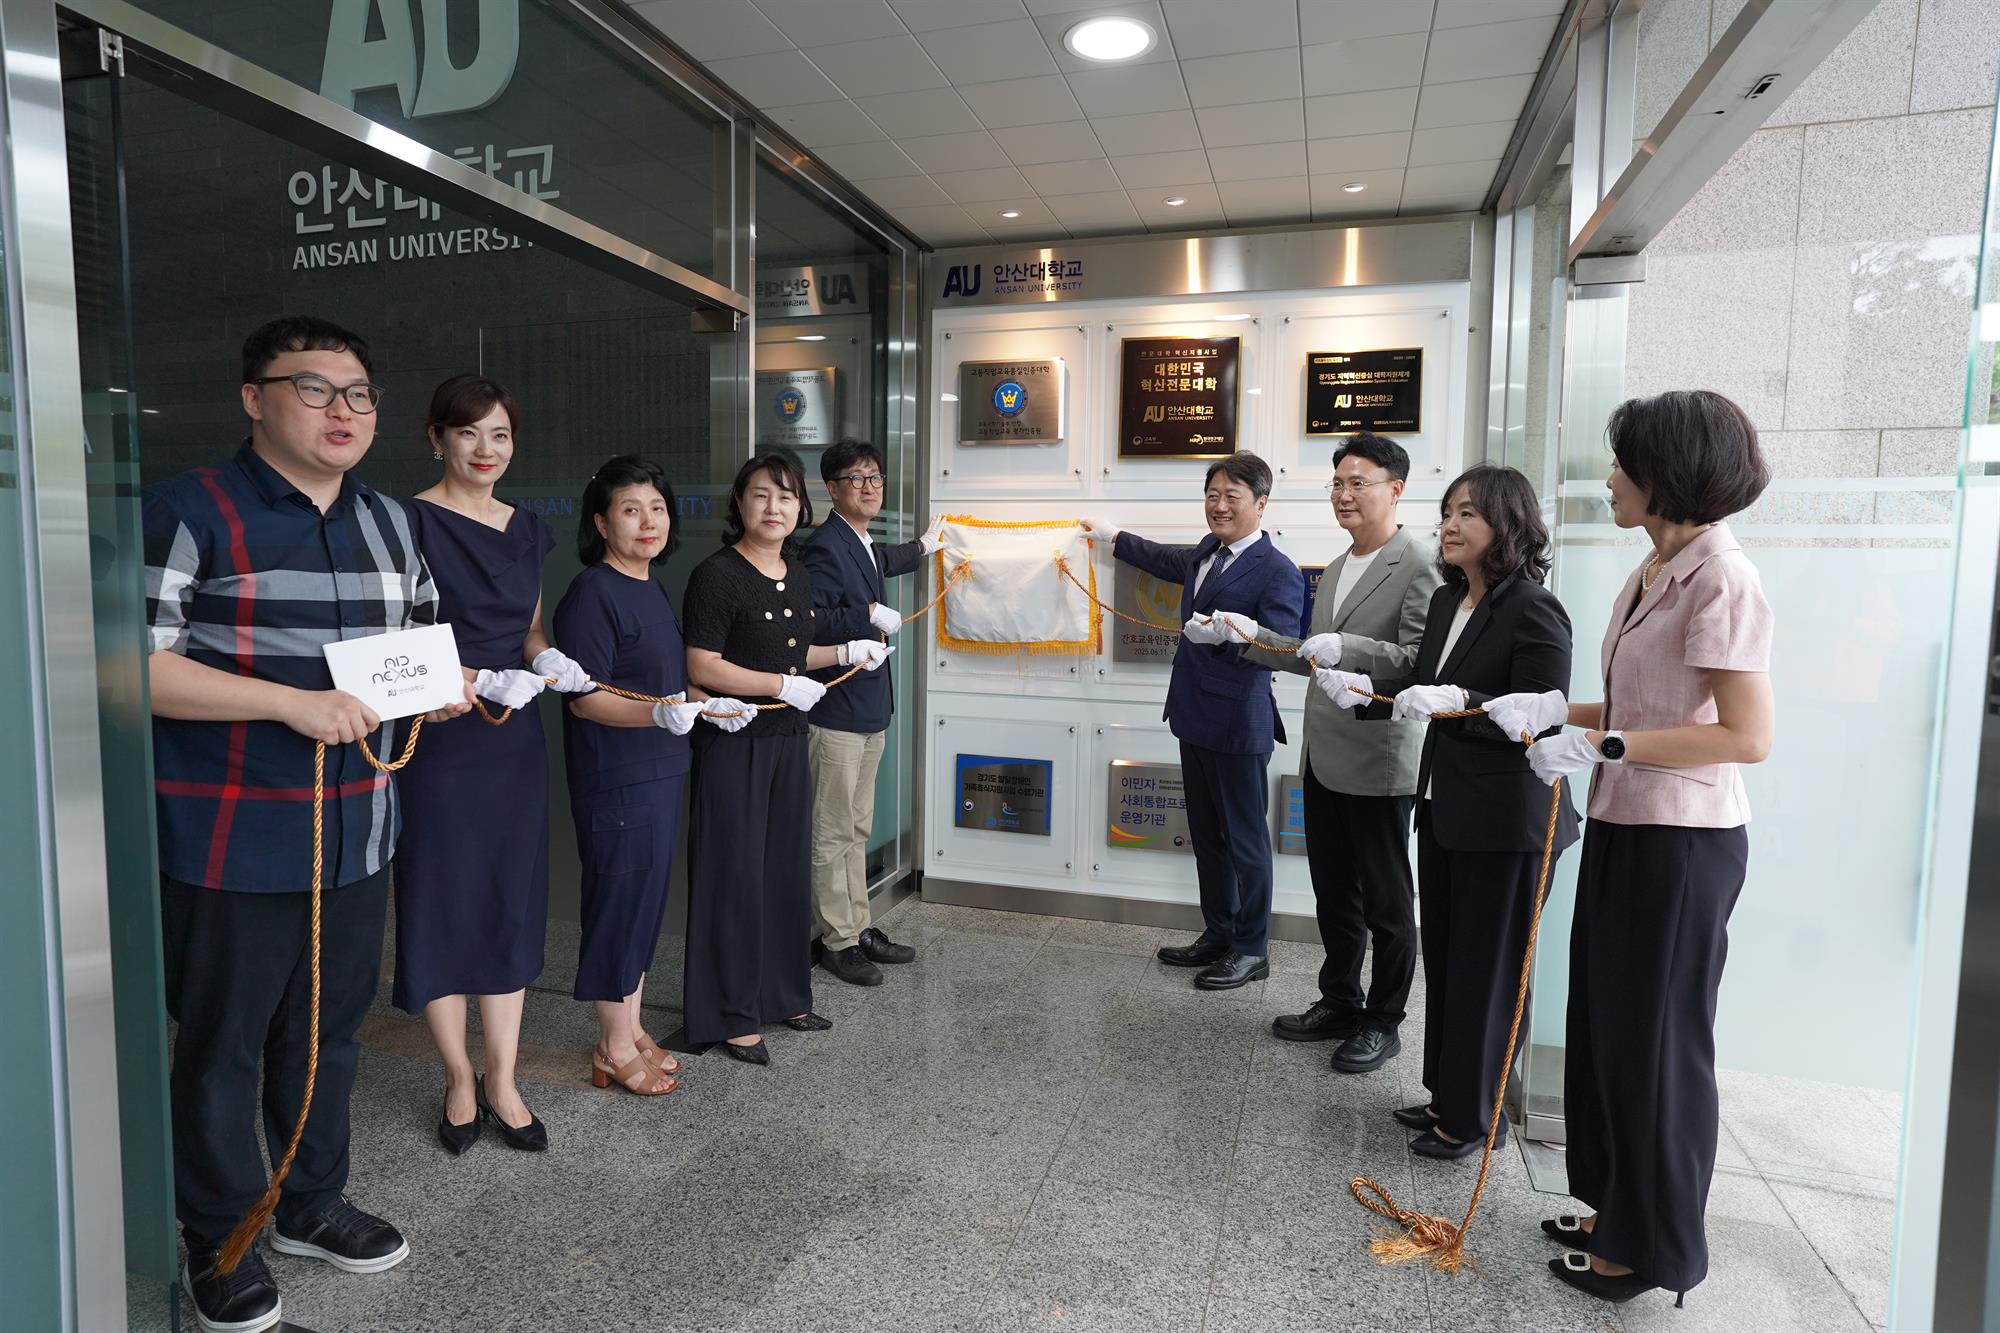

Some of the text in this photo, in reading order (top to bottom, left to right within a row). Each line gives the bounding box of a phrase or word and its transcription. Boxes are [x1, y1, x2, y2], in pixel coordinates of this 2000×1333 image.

[292, 239, 377, 270] ANSAN
[993, 260, 1083, 283] 안산대학교
[942, 264, 981, 298] AU
[994, 281, 1083, 294] ANSAN UNIVERSITY
[1154, 362, 1205, 376] 대한민국
[1141, 377, 1218, 392] 혁신전문대학
[1334, 394, 1352, 408] AU
[1356, 394, 1394, 403] 안산대학교
[1143, 405, 1165, 423] AU
[1167, 405, 1214, 416] 안산대학교
[1121, 777, 1155, 791] 이민자
[1120, 811, 1166, 826] 운영기관
